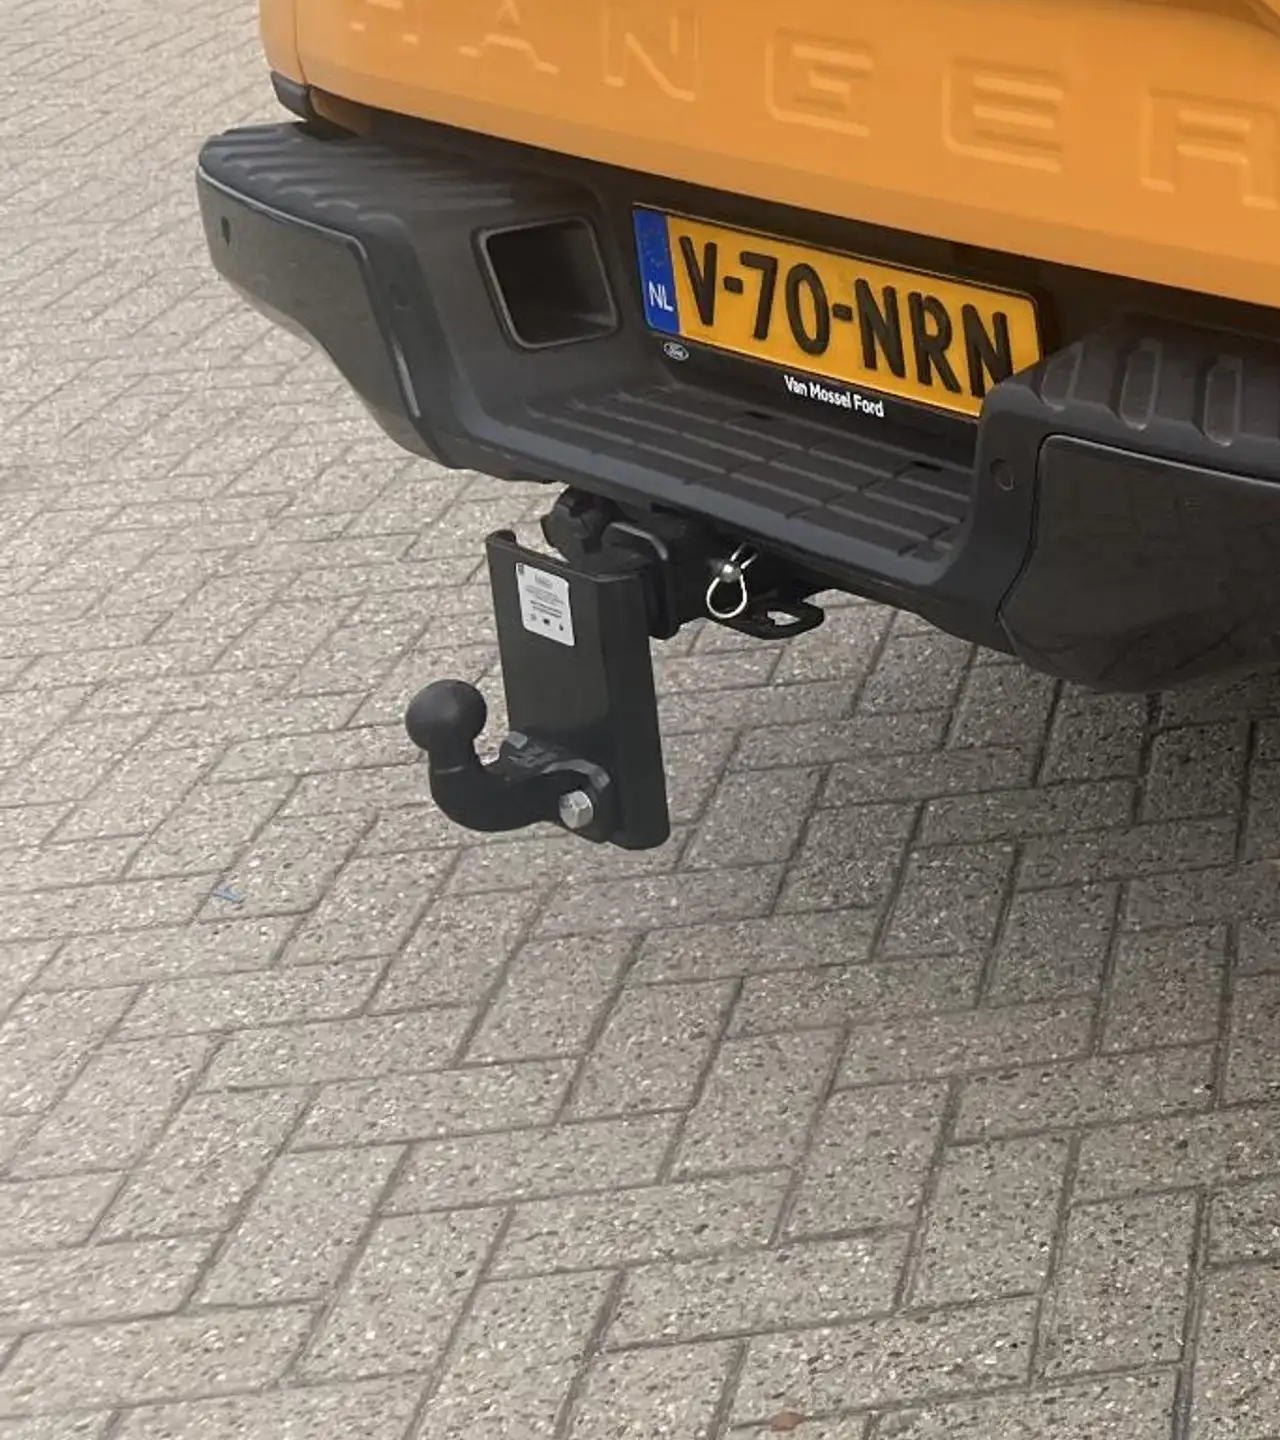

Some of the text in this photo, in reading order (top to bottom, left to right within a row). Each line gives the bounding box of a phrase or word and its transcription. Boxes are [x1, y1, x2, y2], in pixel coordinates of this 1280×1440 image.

[648, 281, 674, 313] NL
[679, 236, 1013, 398] V-70-NRN
[783, 374, 885, 418] Van Mossel Ford
